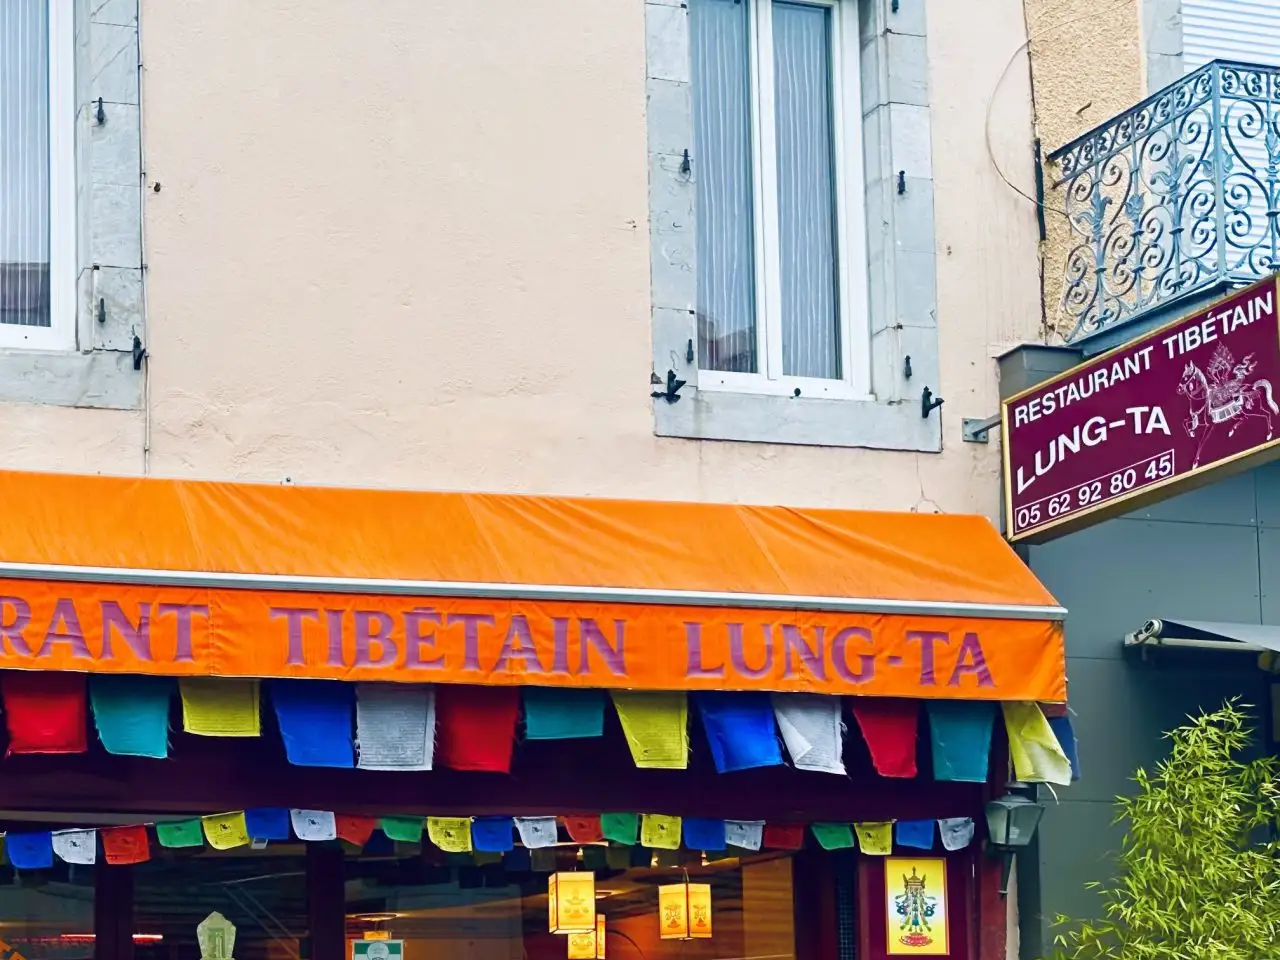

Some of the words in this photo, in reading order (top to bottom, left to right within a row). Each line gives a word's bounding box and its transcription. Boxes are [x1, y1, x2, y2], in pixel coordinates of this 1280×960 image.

[1014, 346, 1154, 427] RESTAURANT
[1162, 291, 1273, 359] TIBÉTAIN
[1017, 406, 1171, 494] LUNG-TA
[1017, 505, 1040, 527] 05
[1048, 494, 1070, 517] 62
[1078, 482, 1101, 505] 92
[1110, 469, 1136, 494] 80
[1145, 455, 1171, 479] 45
[270, 606, 628, 676] TIBÉTAIN
[685, 622, 997, 688] LUNG-TA
